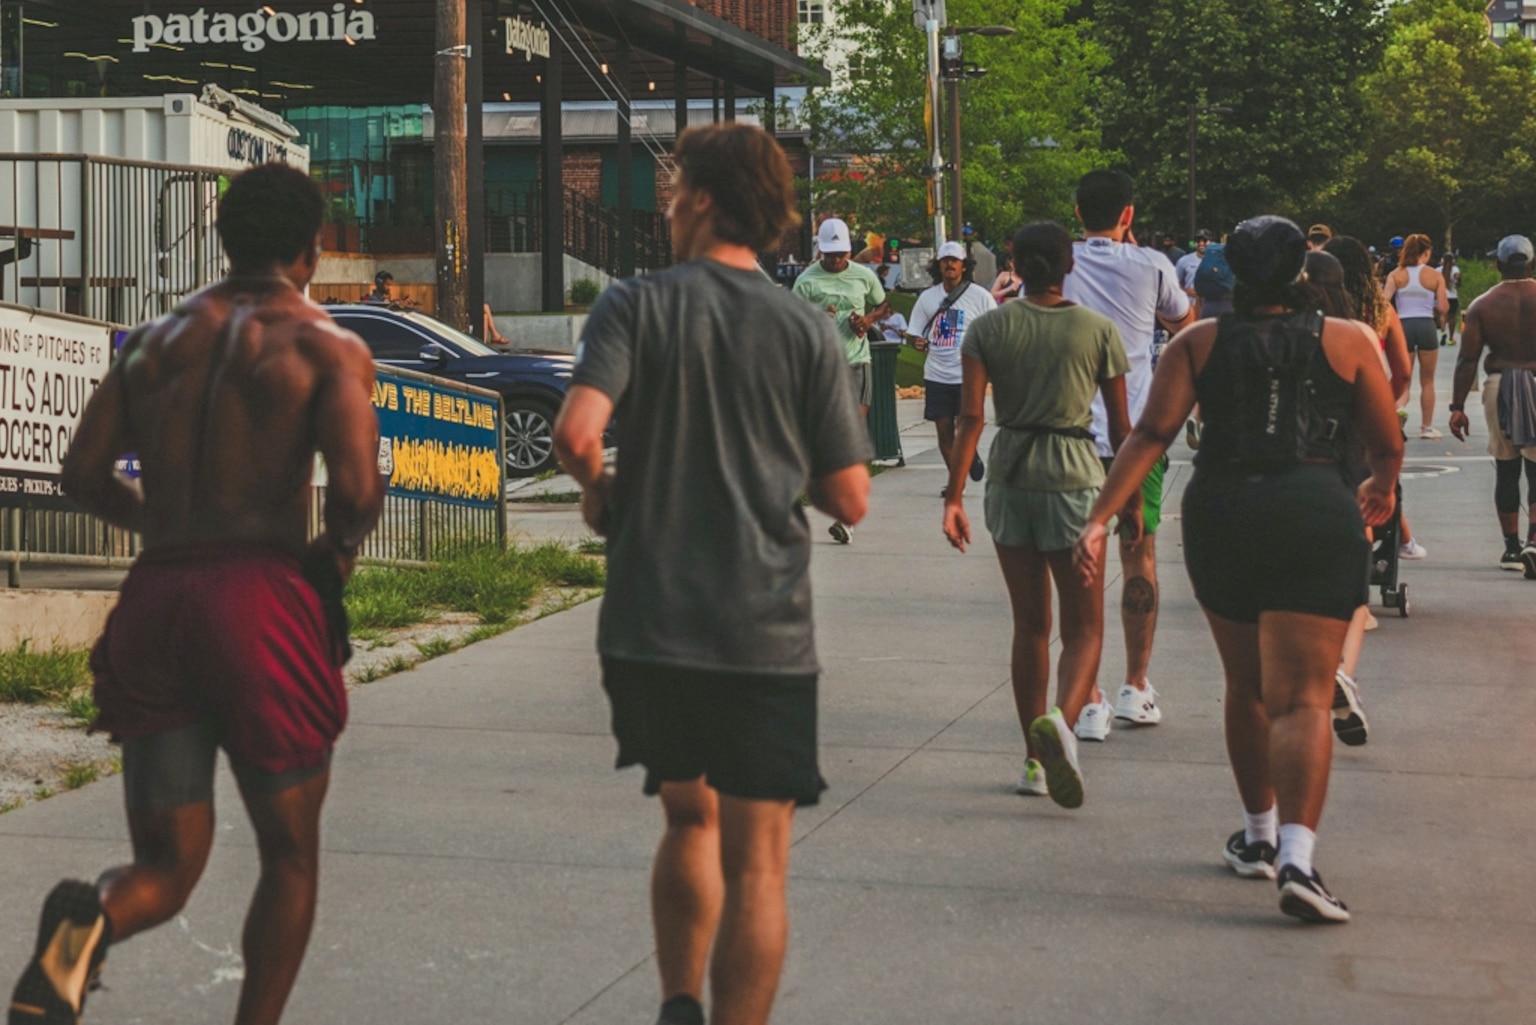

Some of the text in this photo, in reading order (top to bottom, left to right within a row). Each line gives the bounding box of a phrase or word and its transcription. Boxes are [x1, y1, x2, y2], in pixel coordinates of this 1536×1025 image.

[131, 3, 376, 52] patagonia
[505, 14, 550, 62] patagonia
[23, 334, 34, 352] OF
[37, 336, 86, 365] PITCHES
[90, 346, 102, 364] FC
[402, 385, 431, 417] THE
[23, 477, 54, 495] PICKUPS
